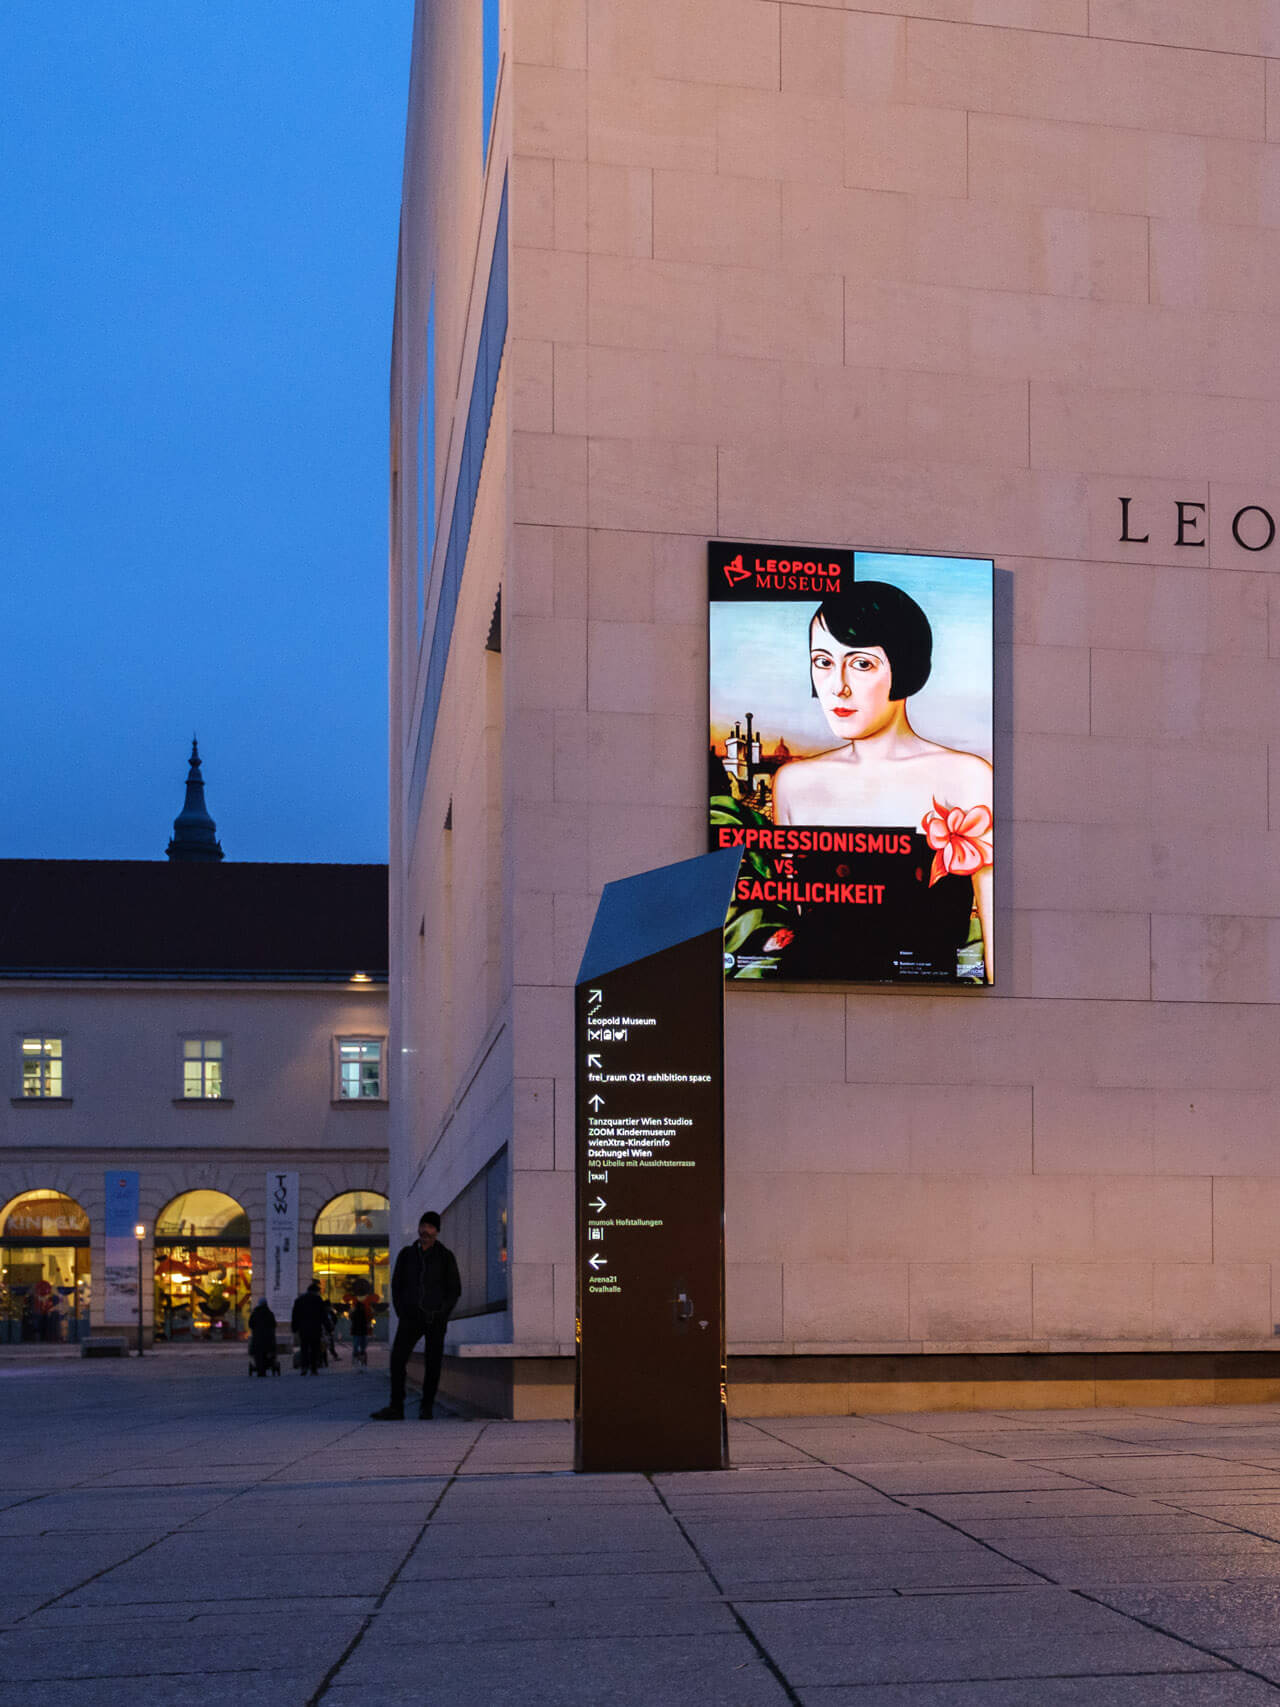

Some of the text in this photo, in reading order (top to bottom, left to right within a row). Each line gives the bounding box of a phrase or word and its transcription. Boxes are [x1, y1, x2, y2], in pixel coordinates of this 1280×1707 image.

[756, 559, 841, 576] LEOPOLD
[756, 574, 840, 592] MUSEUM
[719, 828, 911, 854] EXPRESSIONISMUS
[774, 859, 798, 875] VS.
[738, 880, 885, 904] SACHLICHKEIT
[587, 1016, 657, 1027] Leopold Museum
[628, 1073, 646, 1083] Q21
[646, 1072, 688, 1082] exhibition
[688, 1075, 712, 1084] space
[588, 1117, 693, 1128] Tanzquartier Wien Studios
[588, 1127, 677, 1137] ZOOM Kindermuseum
[587, 1148, 653, 1159] Dschungel Wien
[625, 1159, 639, 1167] mit
[588, 1275, 617, 1283] Arena21
